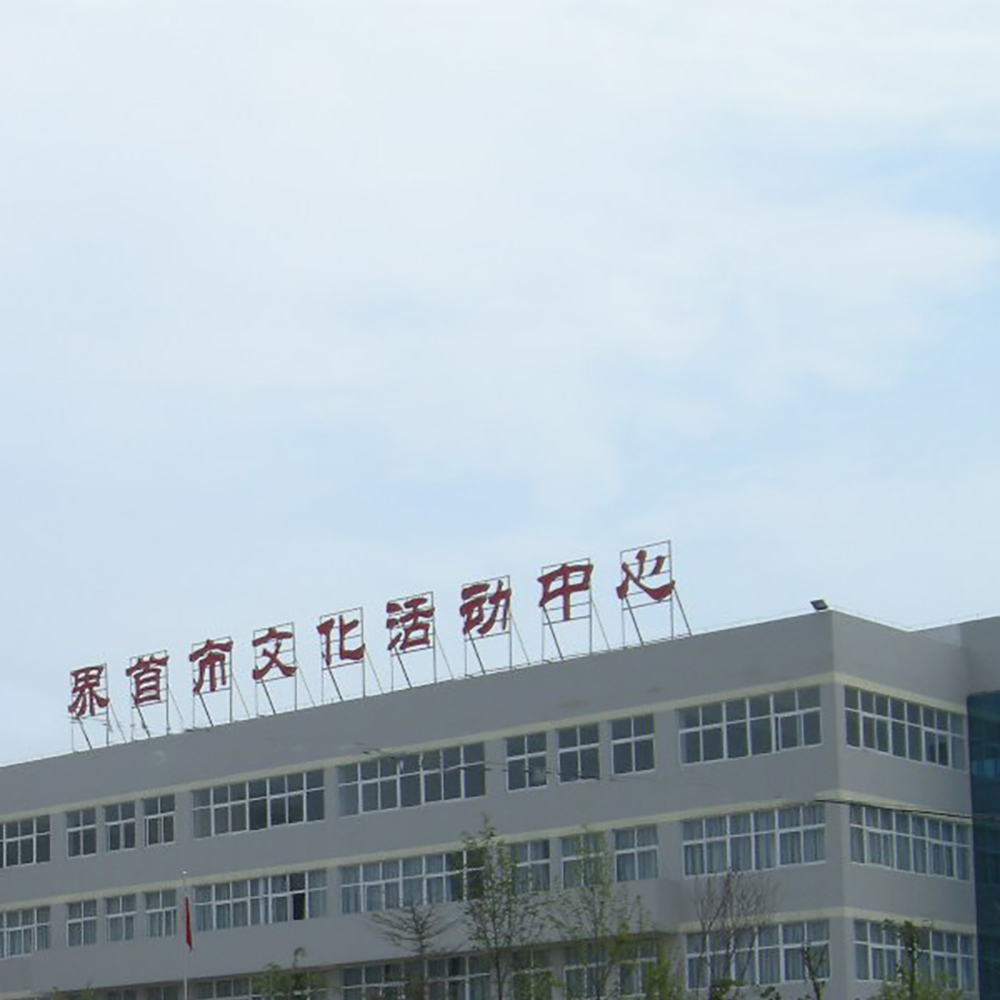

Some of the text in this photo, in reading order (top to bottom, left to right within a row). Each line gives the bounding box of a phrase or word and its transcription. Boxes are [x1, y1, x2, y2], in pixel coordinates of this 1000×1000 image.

[68, 549, 675, 717] 界首市文化活动中心
